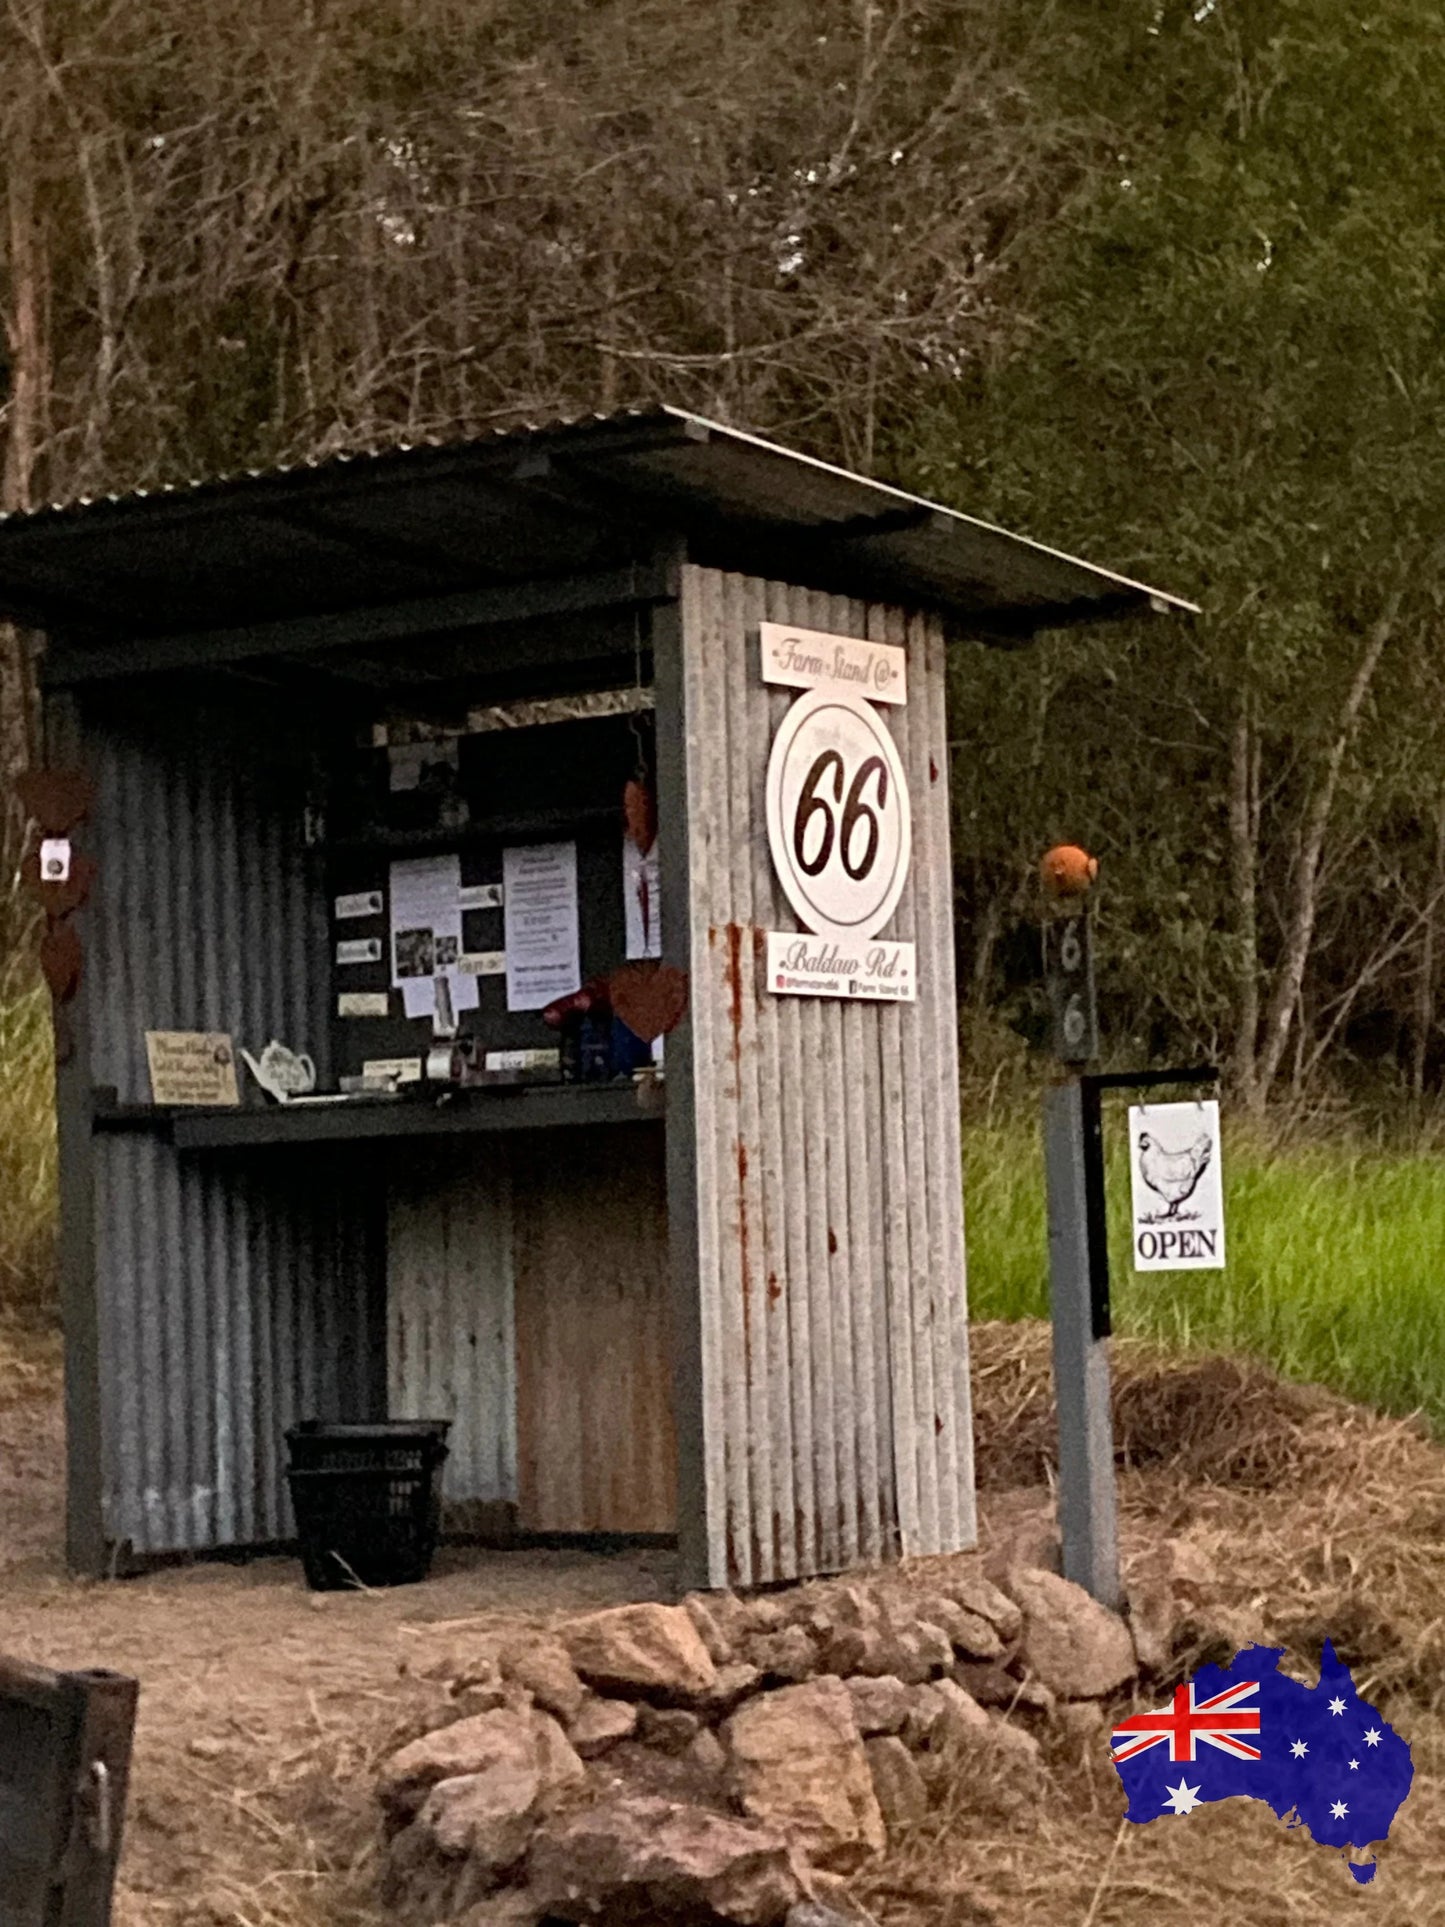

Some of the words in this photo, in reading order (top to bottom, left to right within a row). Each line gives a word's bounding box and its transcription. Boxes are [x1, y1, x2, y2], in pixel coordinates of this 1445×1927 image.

[779, 637, 823, 675] Farm
[830, 644, 875, 684] Stand
[874, 658, 891, 692] @
[793, 749, 889, 882] 66
[865, 947, 900, 978] Rd
[1137, 1229, 1219, 1260] OPEN
